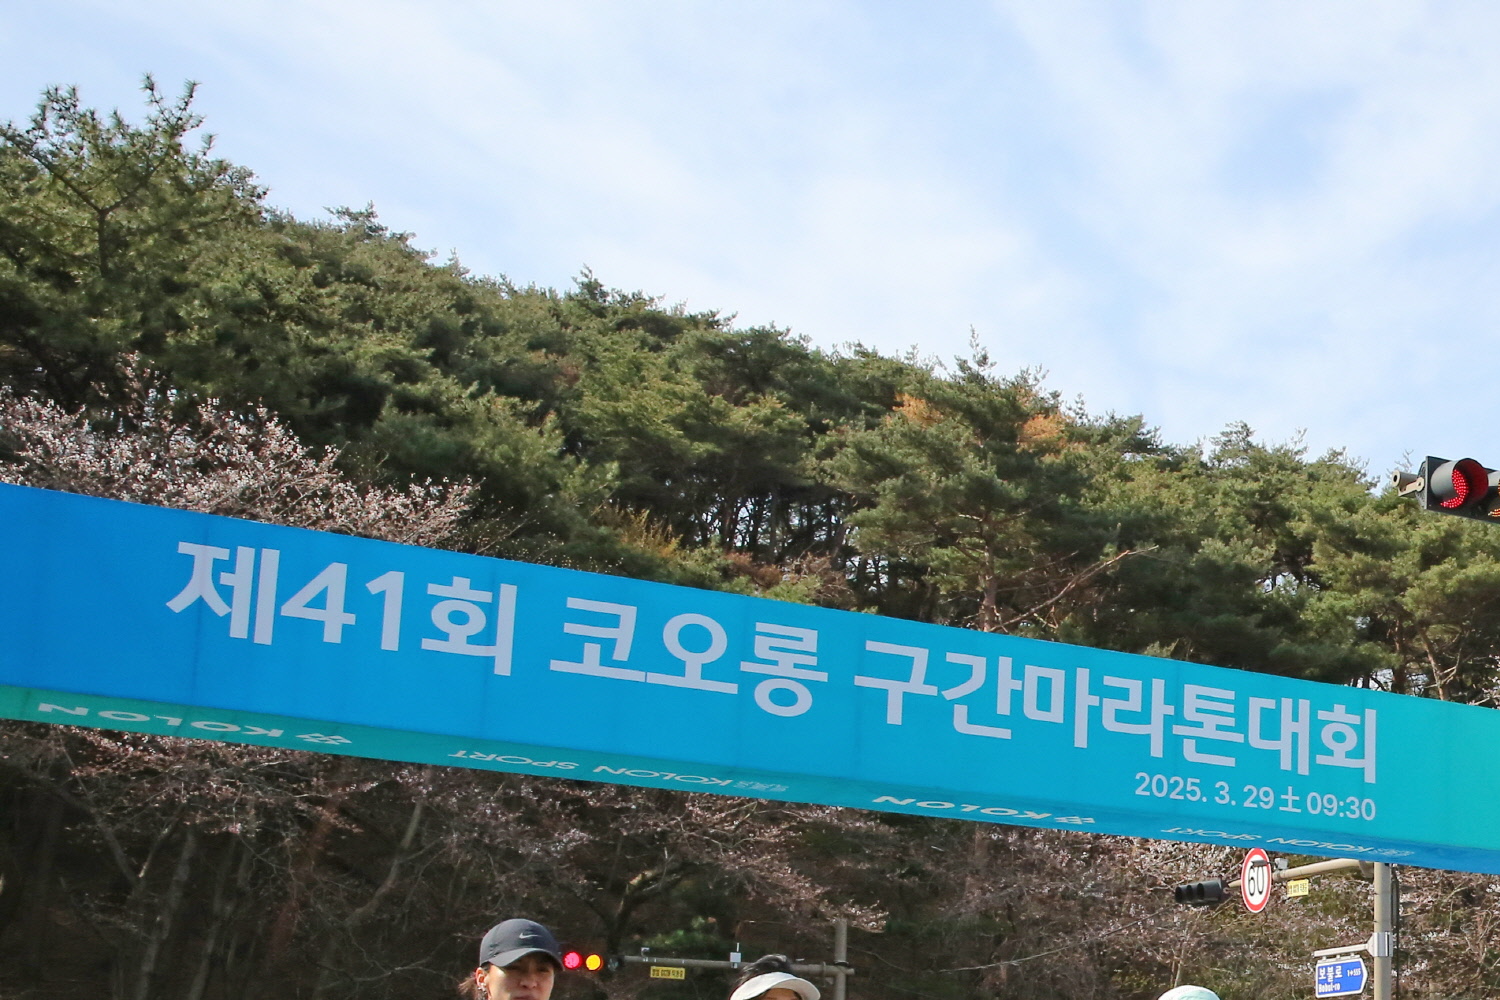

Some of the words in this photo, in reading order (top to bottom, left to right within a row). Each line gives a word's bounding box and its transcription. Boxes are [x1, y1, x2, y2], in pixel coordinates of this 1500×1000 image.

[165, 541, 518, 677] 제41회
[549, 597, 829, 717] 코오롱
[853, 639, 1377, 784] 구간마라톤대회
[38, 702, 283, 739] KOLON
[447, 749, 581, 771] SPORT
[592, 764, 735, 788] KOLON
[871, 794, 1051, 822] KOLON
[1134, 771, 1207, 803] 2025.
[1214, 781, 1237, 806] 3.
[1242, 784, 1275, 810] 29
[1306, 791, 1377, 821] 09:30
[1160, 825, 1262, 843] SPORT
[1266, 836, 1374, 855] KOLON
[1318, 965, 1343, 983] 보불로
